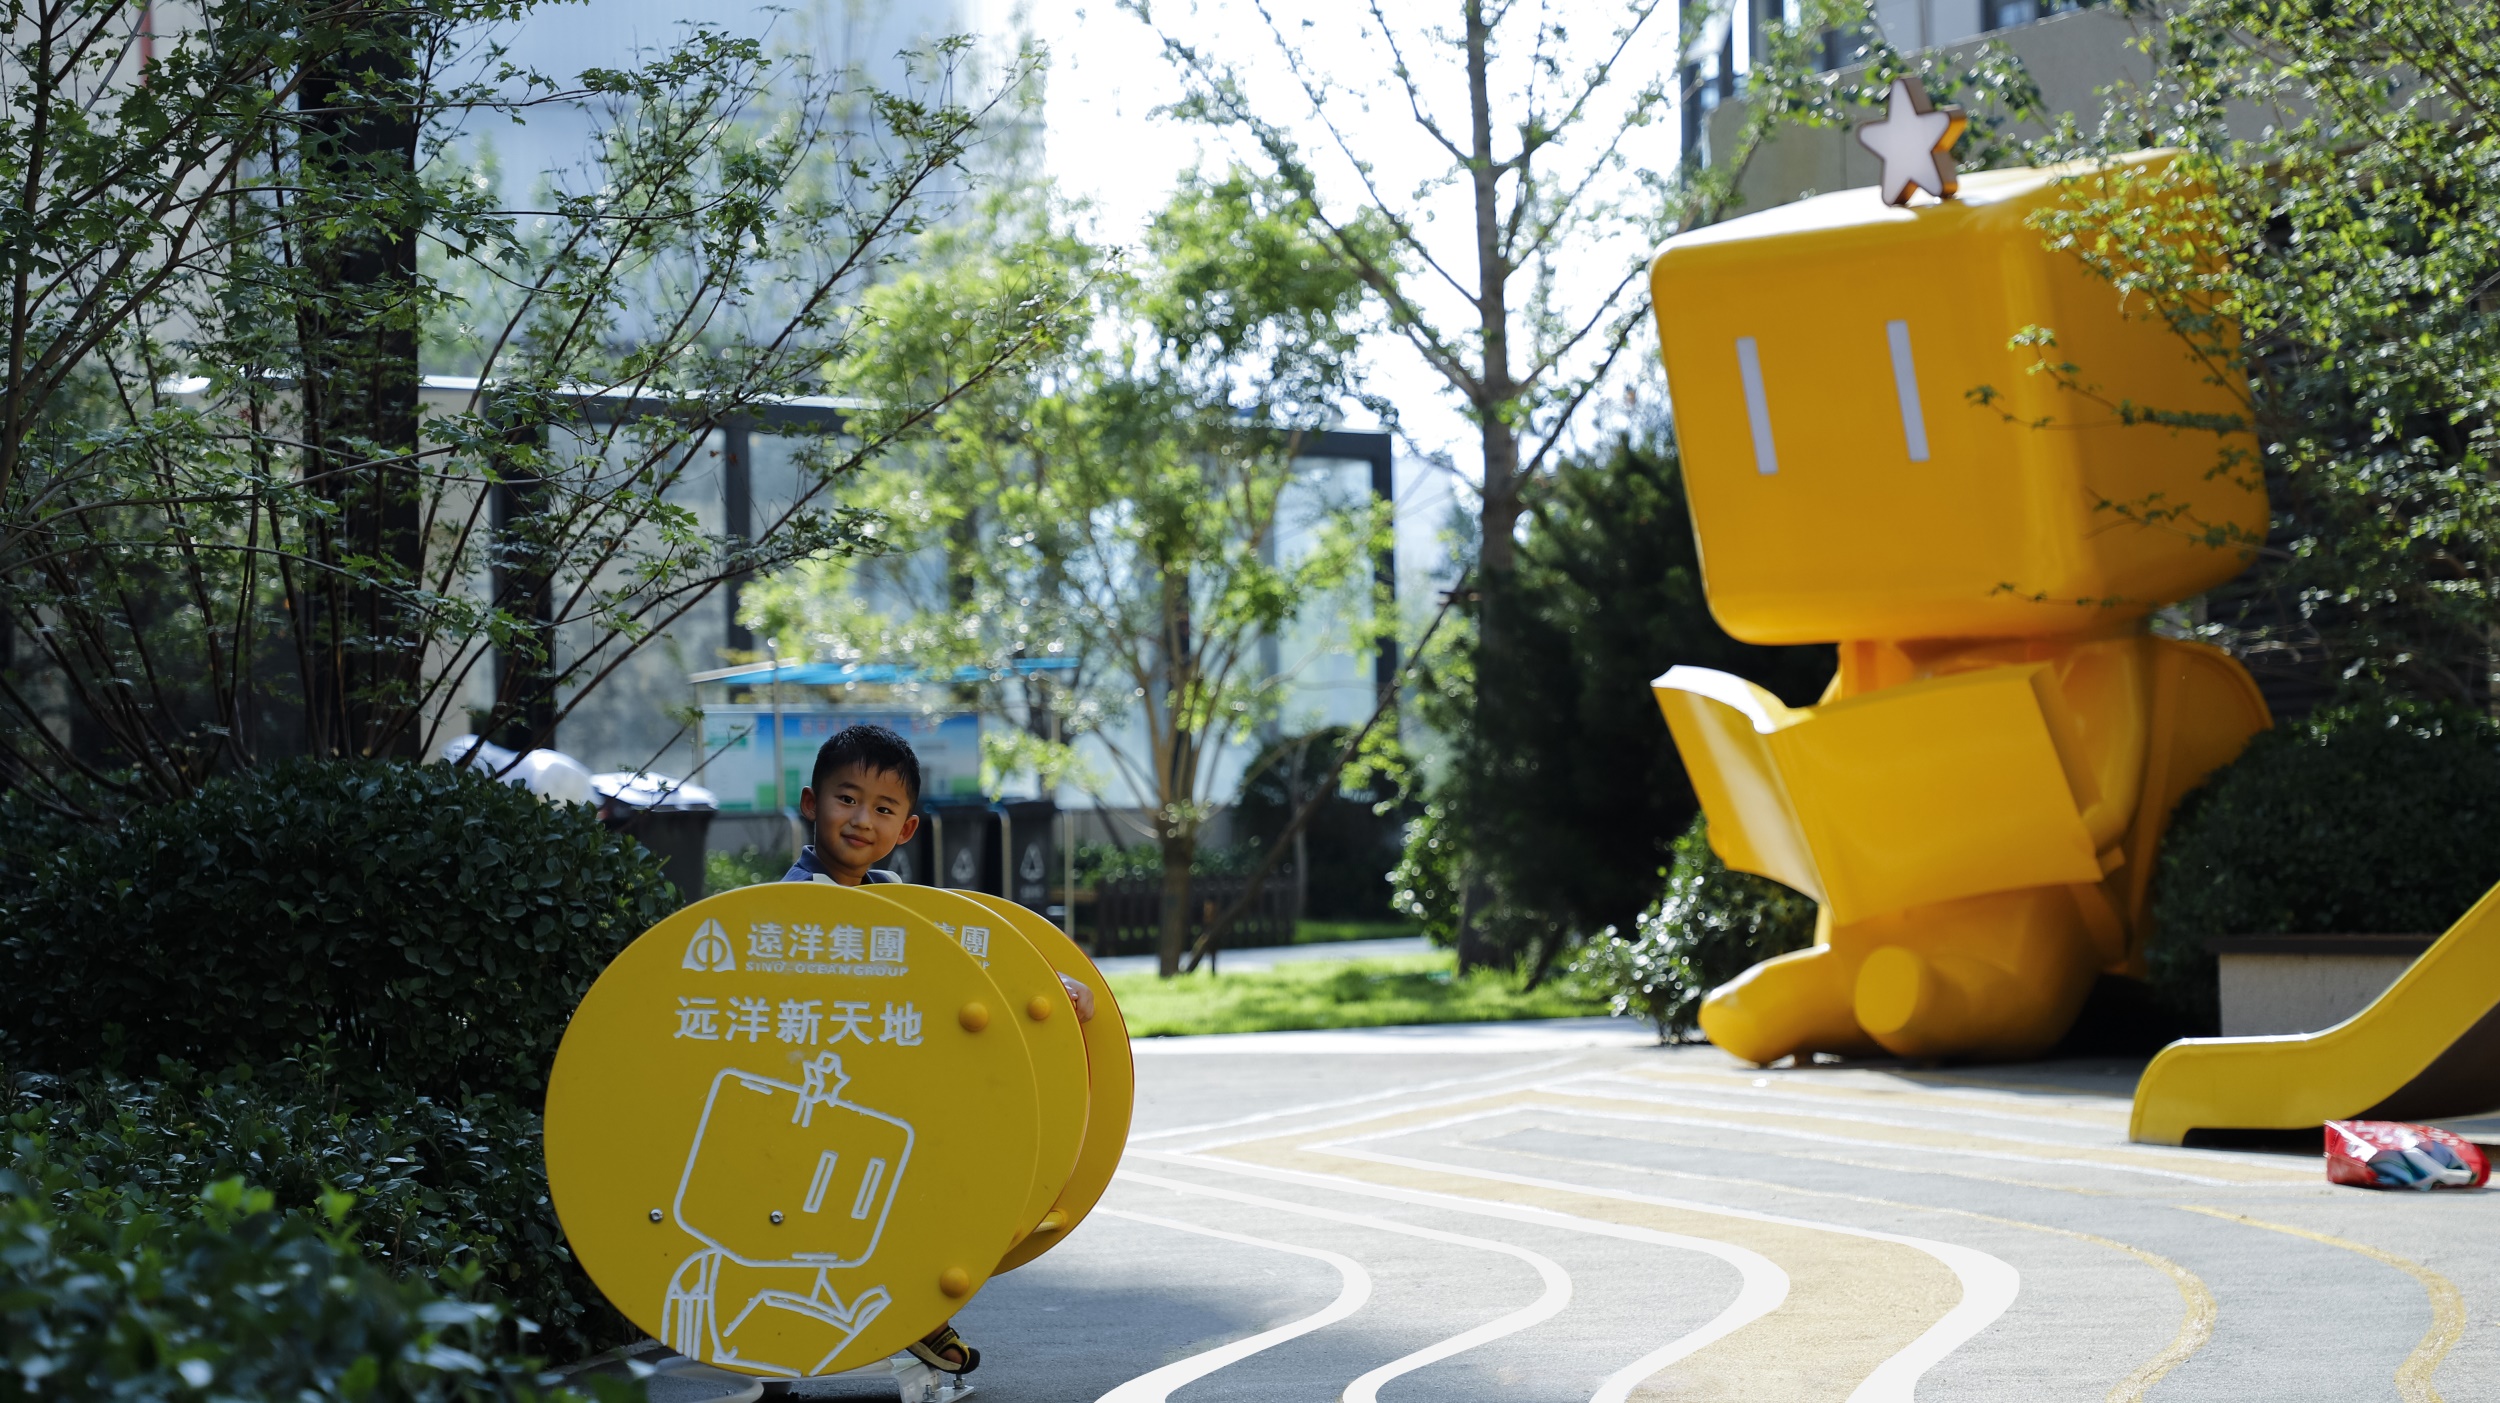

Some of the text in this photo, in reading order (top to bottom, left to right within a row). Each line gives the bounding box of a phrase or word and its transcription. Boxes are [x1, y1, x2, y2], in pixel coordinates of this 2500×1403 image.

[747, 921, 905, 962] 遠洋集團
[853, 964, 909, 977] GROUP
[673, 996, 923, 1046] 远洋新天地
